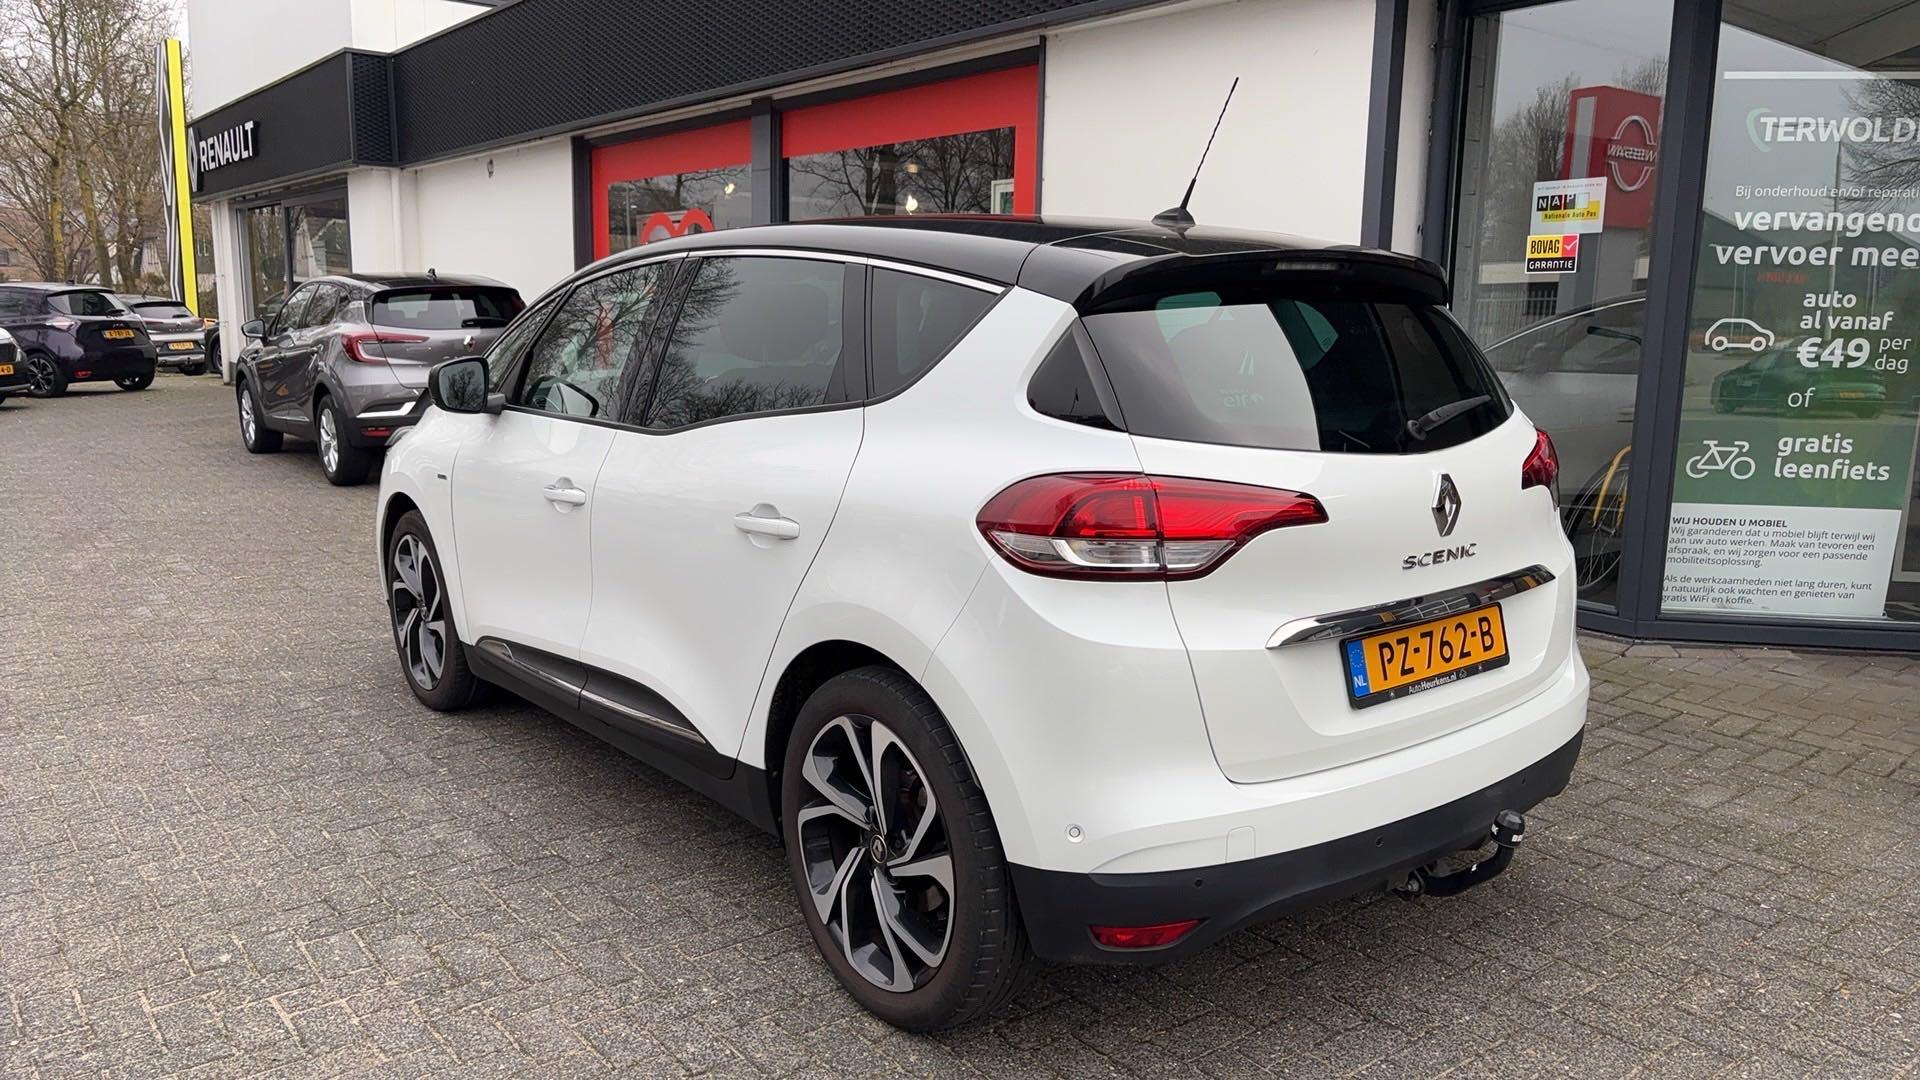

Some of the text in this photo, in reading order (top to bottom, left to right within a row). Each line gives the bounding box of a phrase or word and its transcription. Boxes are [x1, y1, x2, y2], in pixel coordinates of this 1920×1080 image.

[1759, 116, 1920, 143] TERWOLD
[199, 120, 254, 172] RENAULT
[1735, 185, 1751, 199] Bij
[1754, 185, 1827, 198] onderhoud
[1830, 185, 1866, 198] en/of
[1537, 193, 1576, 210] NAP
[1572, 210, 1585, 218] Auto
[1586, 209, 1597, 218] Pas
[1530, 239, 1560, 255] BOVAG
[1715, 244, 1919, 267] vervoer mee
[1529, 259, 1573, 270] GARANTIE
[1803, 291, 1857, 308] auto
[1800, 311, 1894, 331] al vanaf
[1797, 337, 1870, 368] €49
[1880, 337, 1911, 353] per
[1875, 355, 1909, 374] dag
[1788, 387, 1816, 408] of
[1778, 433, 1853, 456] gratis
[1774, 457, 1890, 481] leenfiets
[1672, 516, 1787, 528] WIJ HOUDEN U MOBIEL
[1671, 526, 1685, 536] Wij
[1687, 527, 1742, 537] garanderen
[1745, 528, 1760, 537] dat
[1772, 530, 1805, 539] mobiel
[1807, 530, 1829, 541] blijft
[1831, 532, 1860, 543] terwijl
[1862, 532, 1876, 543] wij
[1669, 537, 1686, 545] aan
[1705, 538, 1727, 546] auto
[1770, 539, 1796, 548] Maak
[1799, 541, 1815, 549] van
[1818, 541, 1854, 550] tevoren
[1857, 543, 1875, 551] een
[1402, 543, 1477, 570] SCENIC
[1666, 556, 1763, 568] mobiliteitsoplossing.
[1668, 546, 1711, 556] afspraak,
[1728, 548, 1741, 557] wij
[1743, 549, 1776, 559] zorgen
[1778, 550, 1800, 558] voor
[1802, 551, 1820, 559] een
[1822, 551, 1868, 561] passende
[1664, 574, 1872, 590] Als de werkzaamheden niet lang duren, kunt
[1671, 585, 1716, 595] natuurlijk
[1718, 586, 1736, 595] ook
[1738, 587, 1777, 597] wachten
[1780, 589, 1792, 597] en
[1794, 589, 1836, 599] genieten
[1838, 591, 1855, 599] van
[1689, 594, 1709, 603] WiFi
[1711, 596, 1723, 604] en
[1725, 596, 1755, 605] koffie.
[1378, 616, 1495, 681] PZ-762-B
[1353, 674, 1367, 688] NL
[1408, 671, 1457, 694] AutoHeurkens.nl
